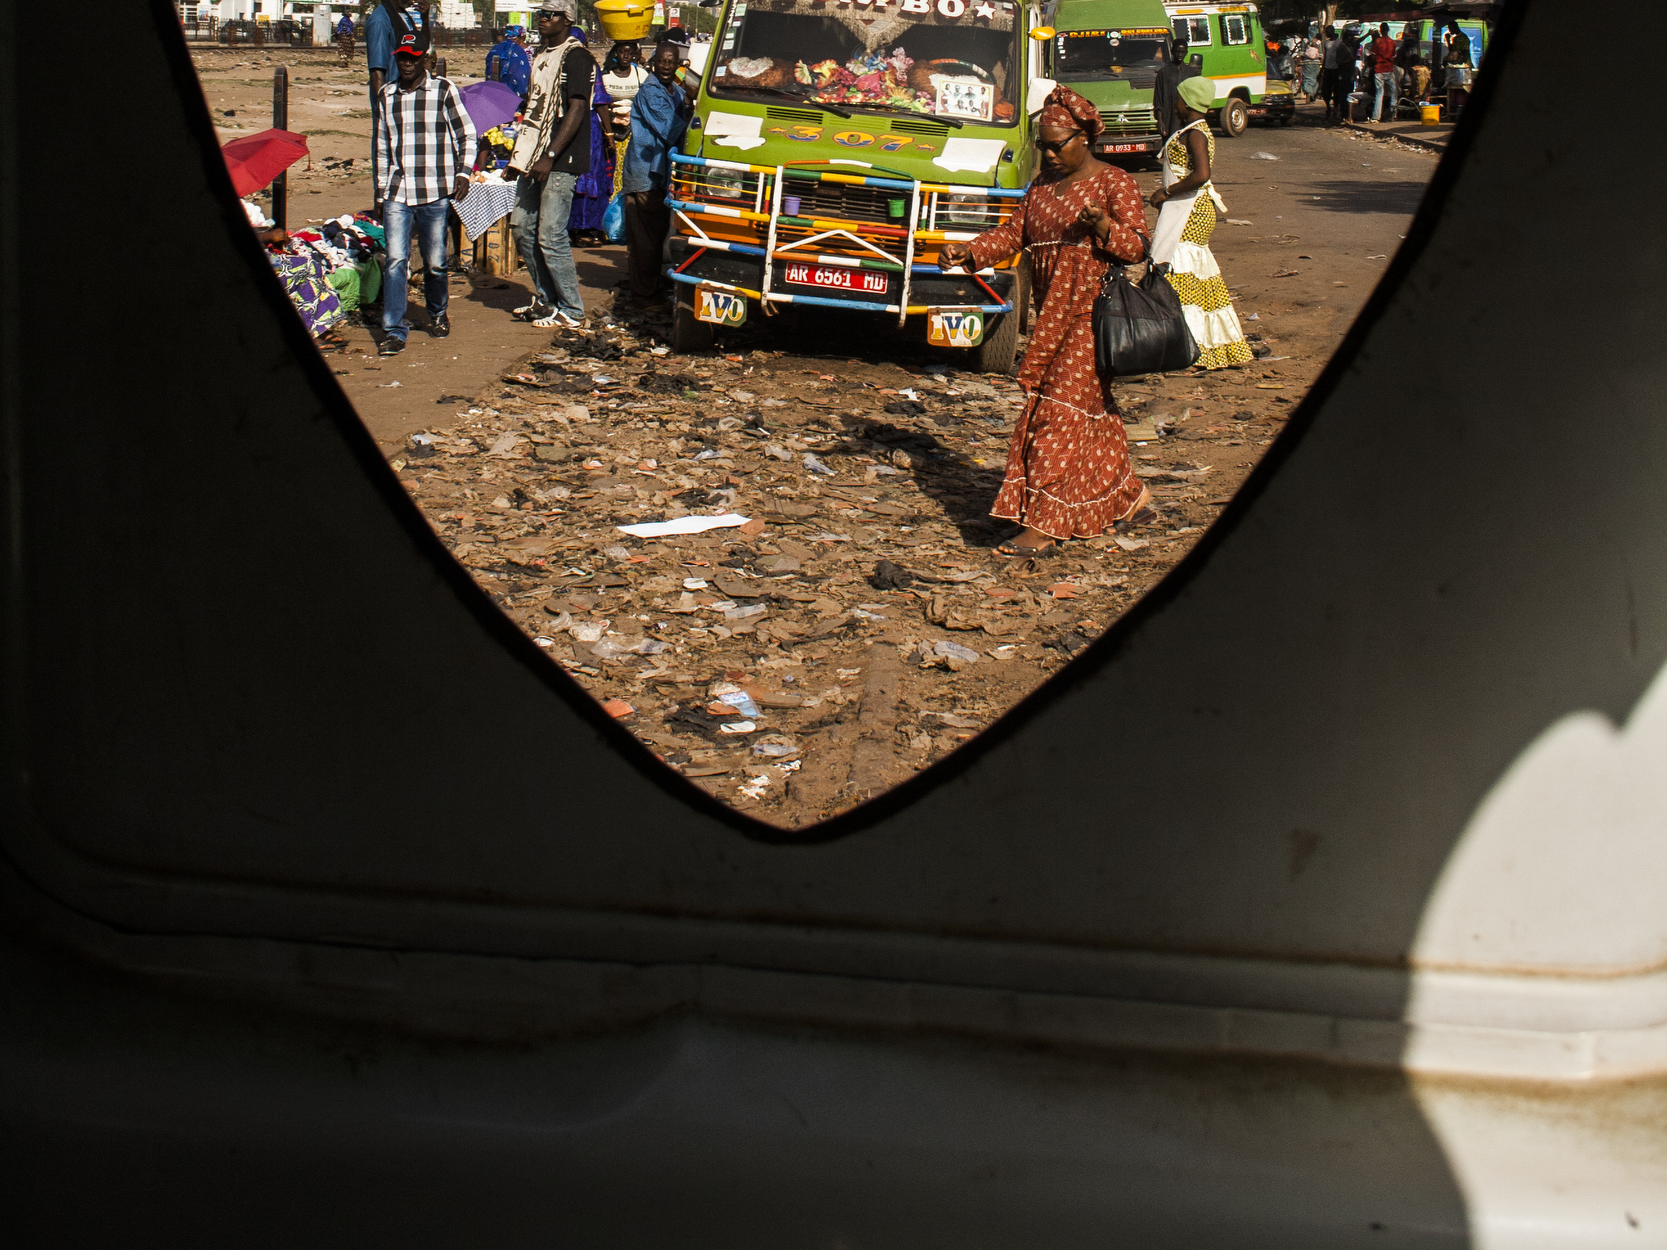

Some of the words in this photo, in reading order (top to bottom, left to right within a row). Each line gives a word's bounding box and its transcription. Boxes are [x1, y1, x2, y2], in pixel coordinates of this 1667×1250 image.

[1115, 144, 1132, 152] 0933
[1135, 143, 1145, 151] MD
[788, 263, 809, 282] AR
[815, 267, 852, 287] 6561
[863, 272, 884, 291] MD
